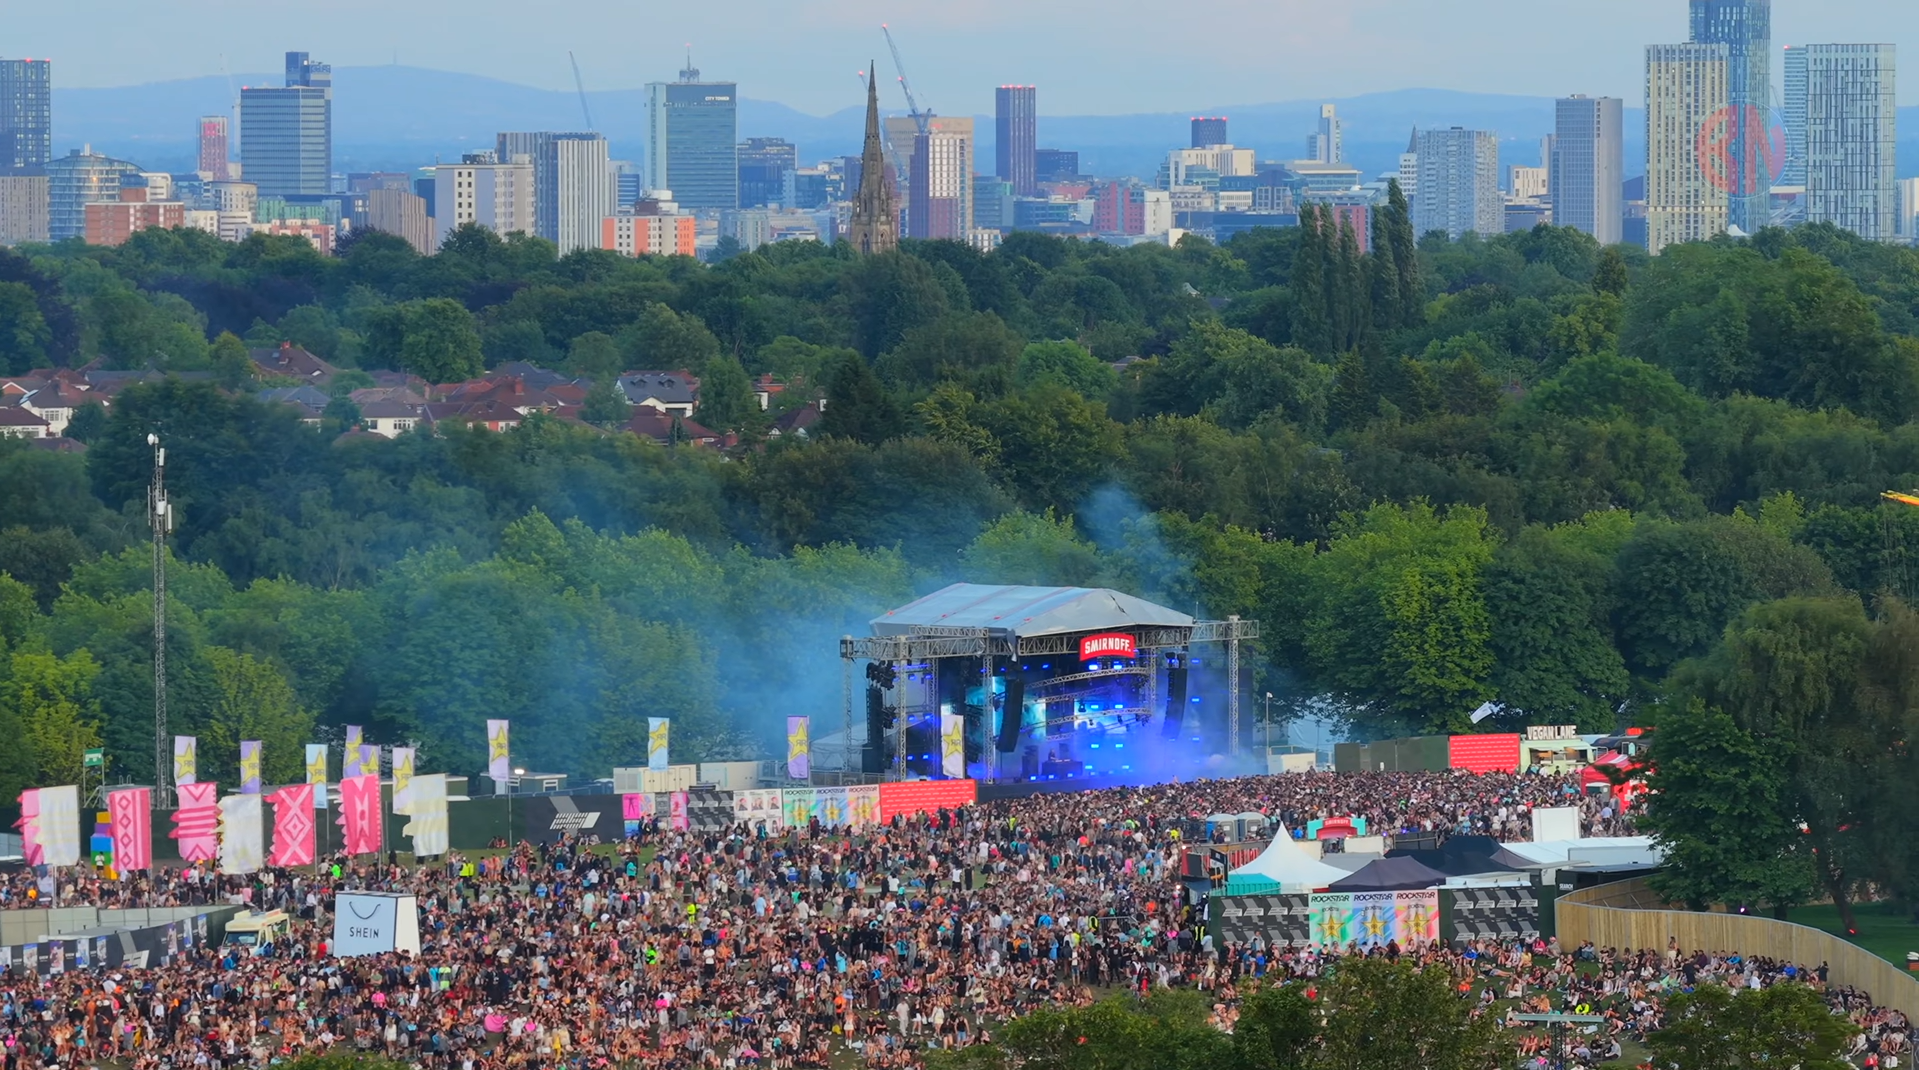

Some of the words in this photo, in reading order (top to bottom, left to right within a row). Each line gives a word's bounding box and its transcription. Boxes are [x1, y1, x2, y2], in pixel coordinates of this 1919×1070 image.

[1526, 726, 1555, 740] VEGAN
[1554, 725, 1577, 739] LANE
[1310, 894, 1350, 903] ROCKSTAR
[1353, 893, 1393, 902] ROCKSTAR
[1396, 891, 1436, 900] ROCKSTAR
[349, 926, 379, 939] SHEIN
